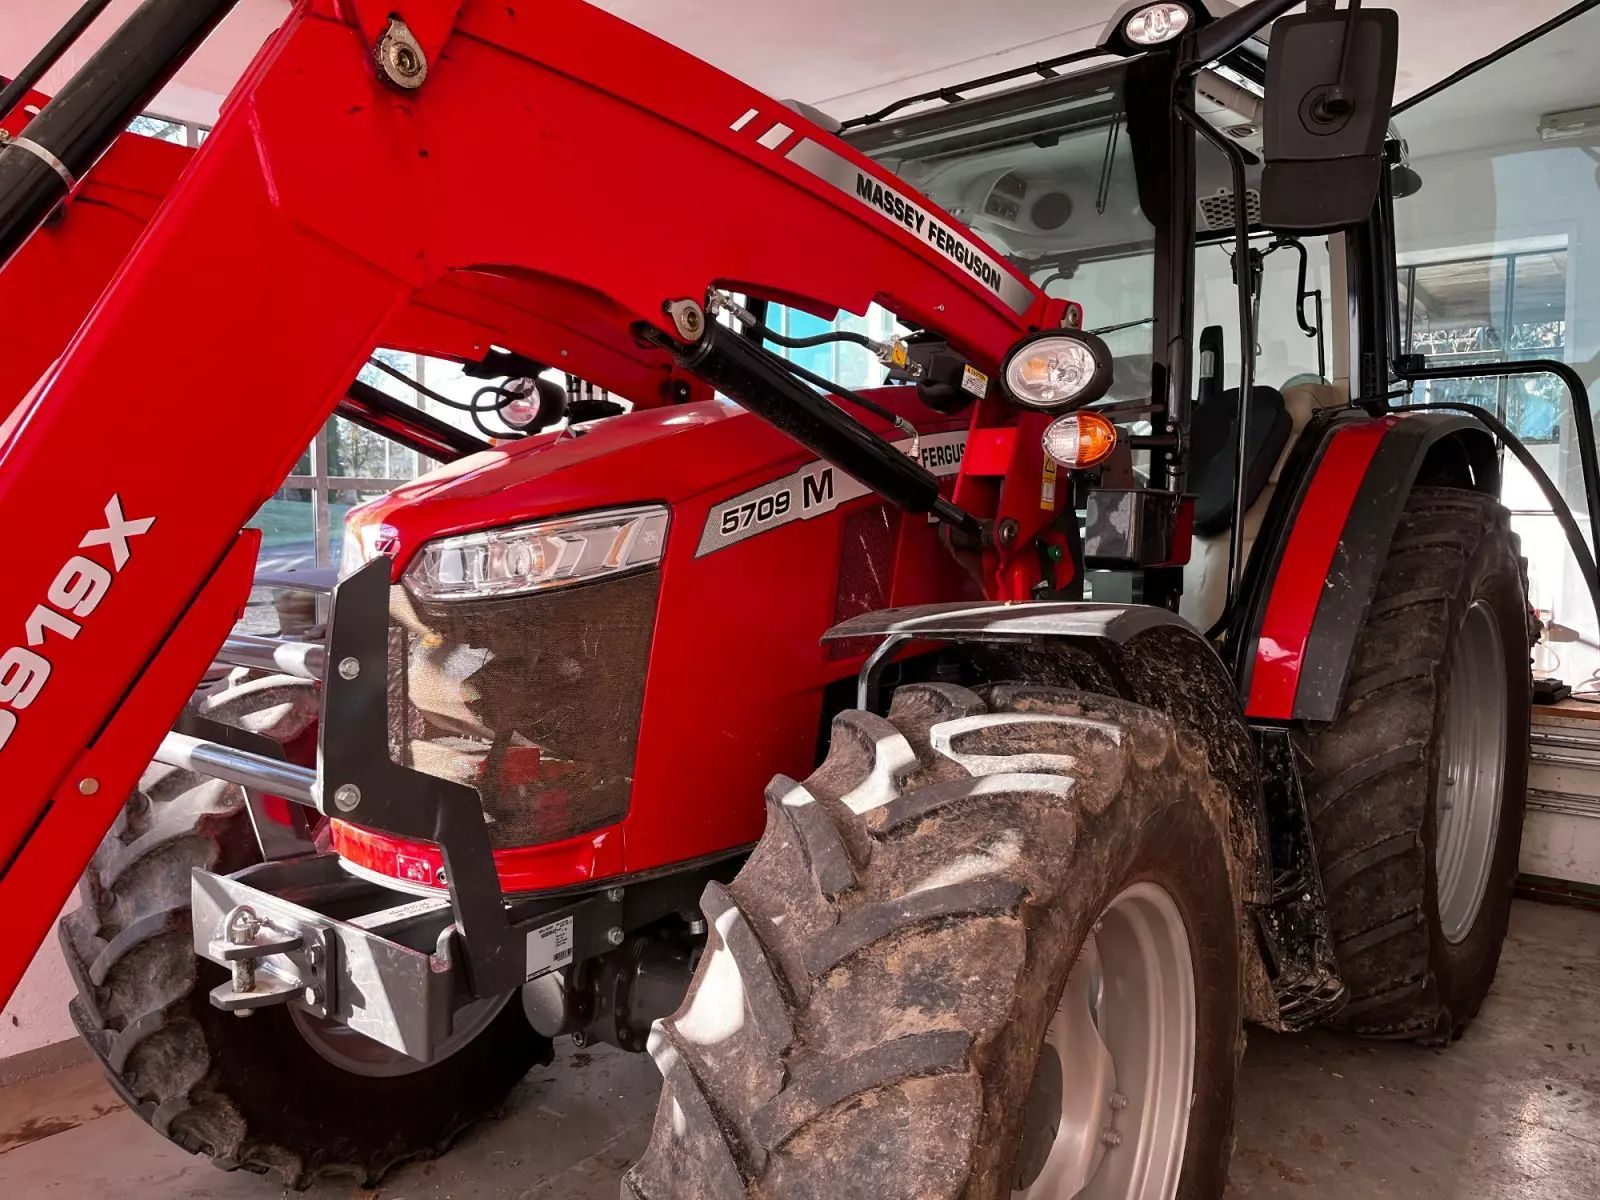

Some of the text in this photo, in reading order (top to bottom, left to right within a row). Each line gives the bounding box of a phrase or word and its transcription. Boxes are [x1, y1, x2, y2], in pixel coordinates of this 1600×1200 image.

[856, 173, 1001, 293] MASSEY FERGUSON
[719, 468, 834, 535] 5709 M
